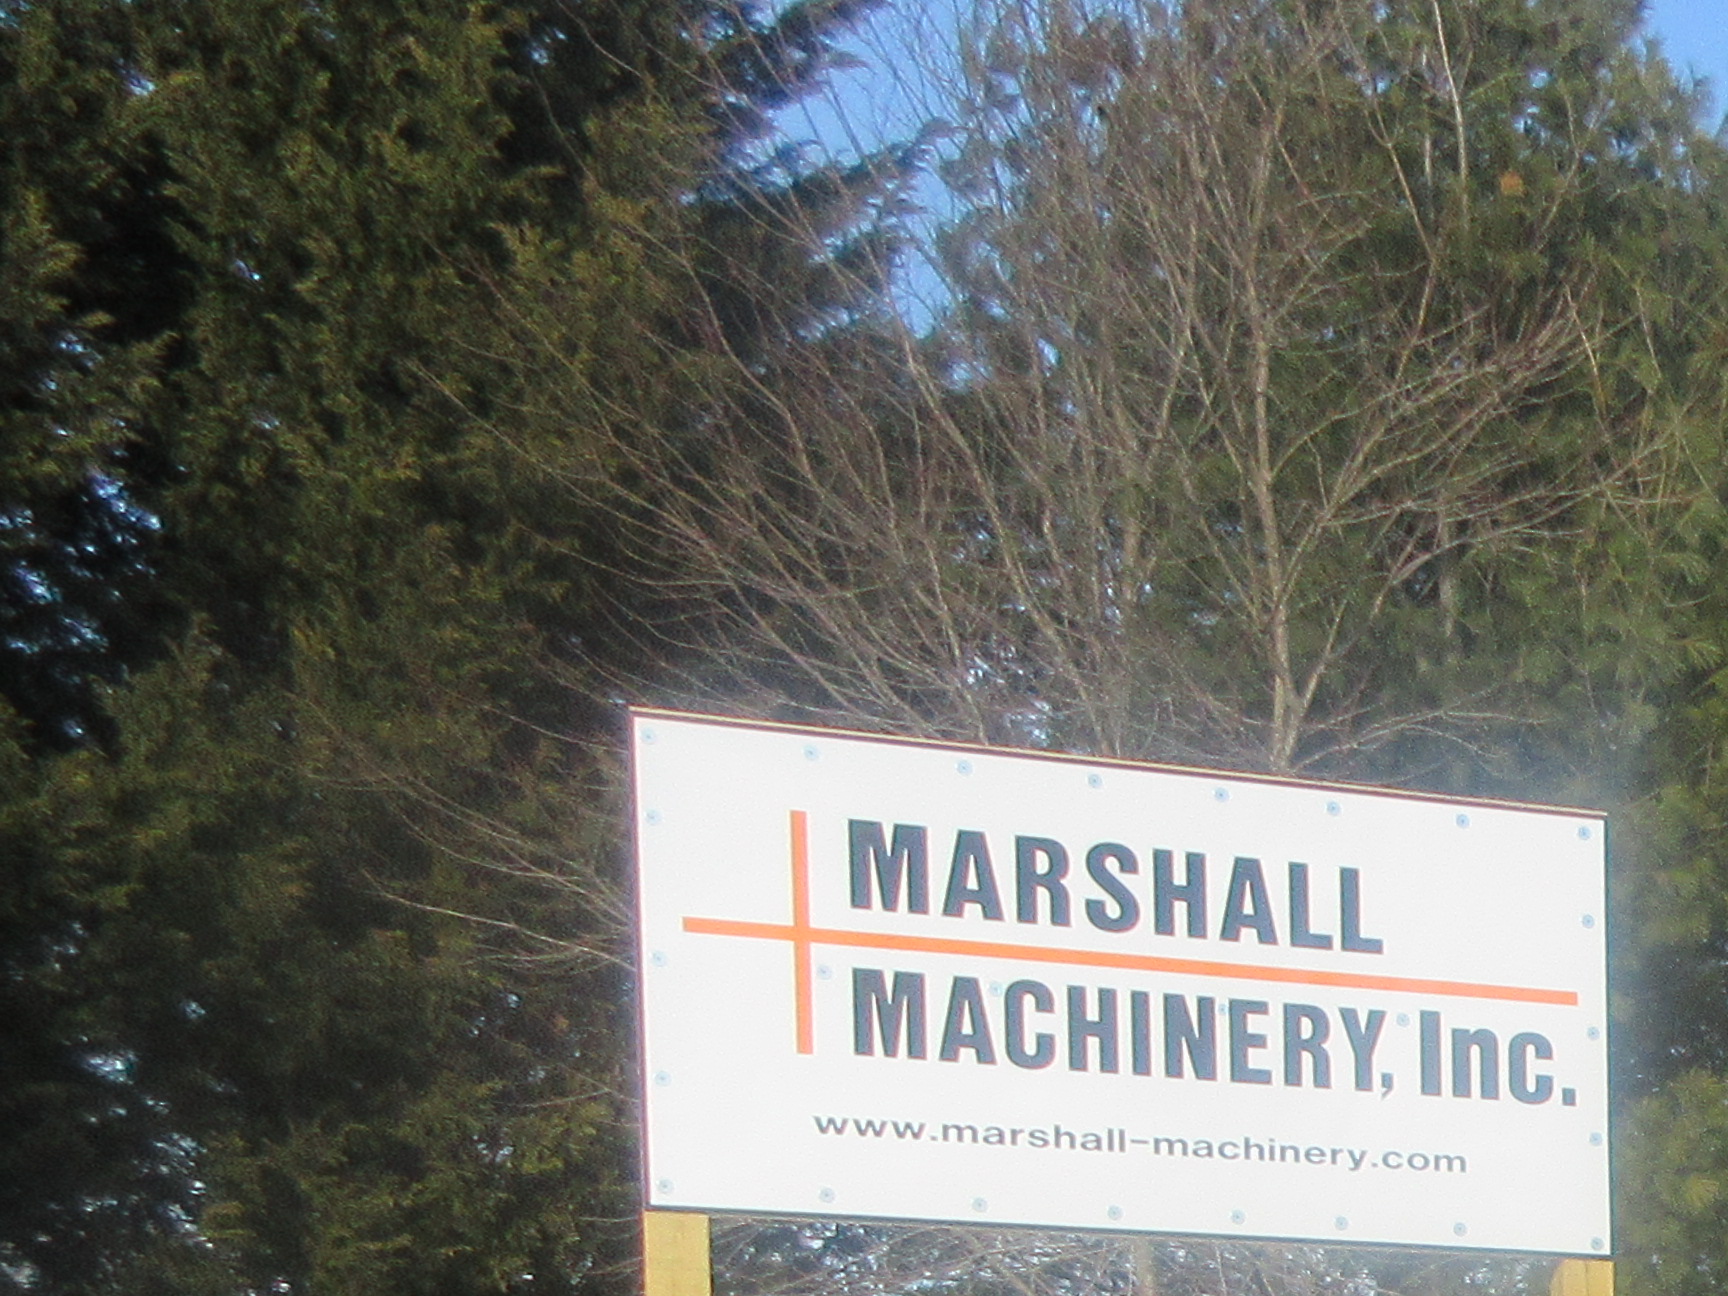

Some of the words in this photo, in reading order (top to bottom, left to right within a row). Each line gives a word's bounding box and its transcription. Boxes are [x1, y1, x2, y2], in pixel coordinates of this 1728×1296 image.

[847, 818, 1384, 954] MARSHALL
[851, 967, 1395, 1098] MACHINERY,
[1420, 1011, 1578, 1106] Inc.
[813, 1113, 1468, 1173] www.marshall-machinery.com
